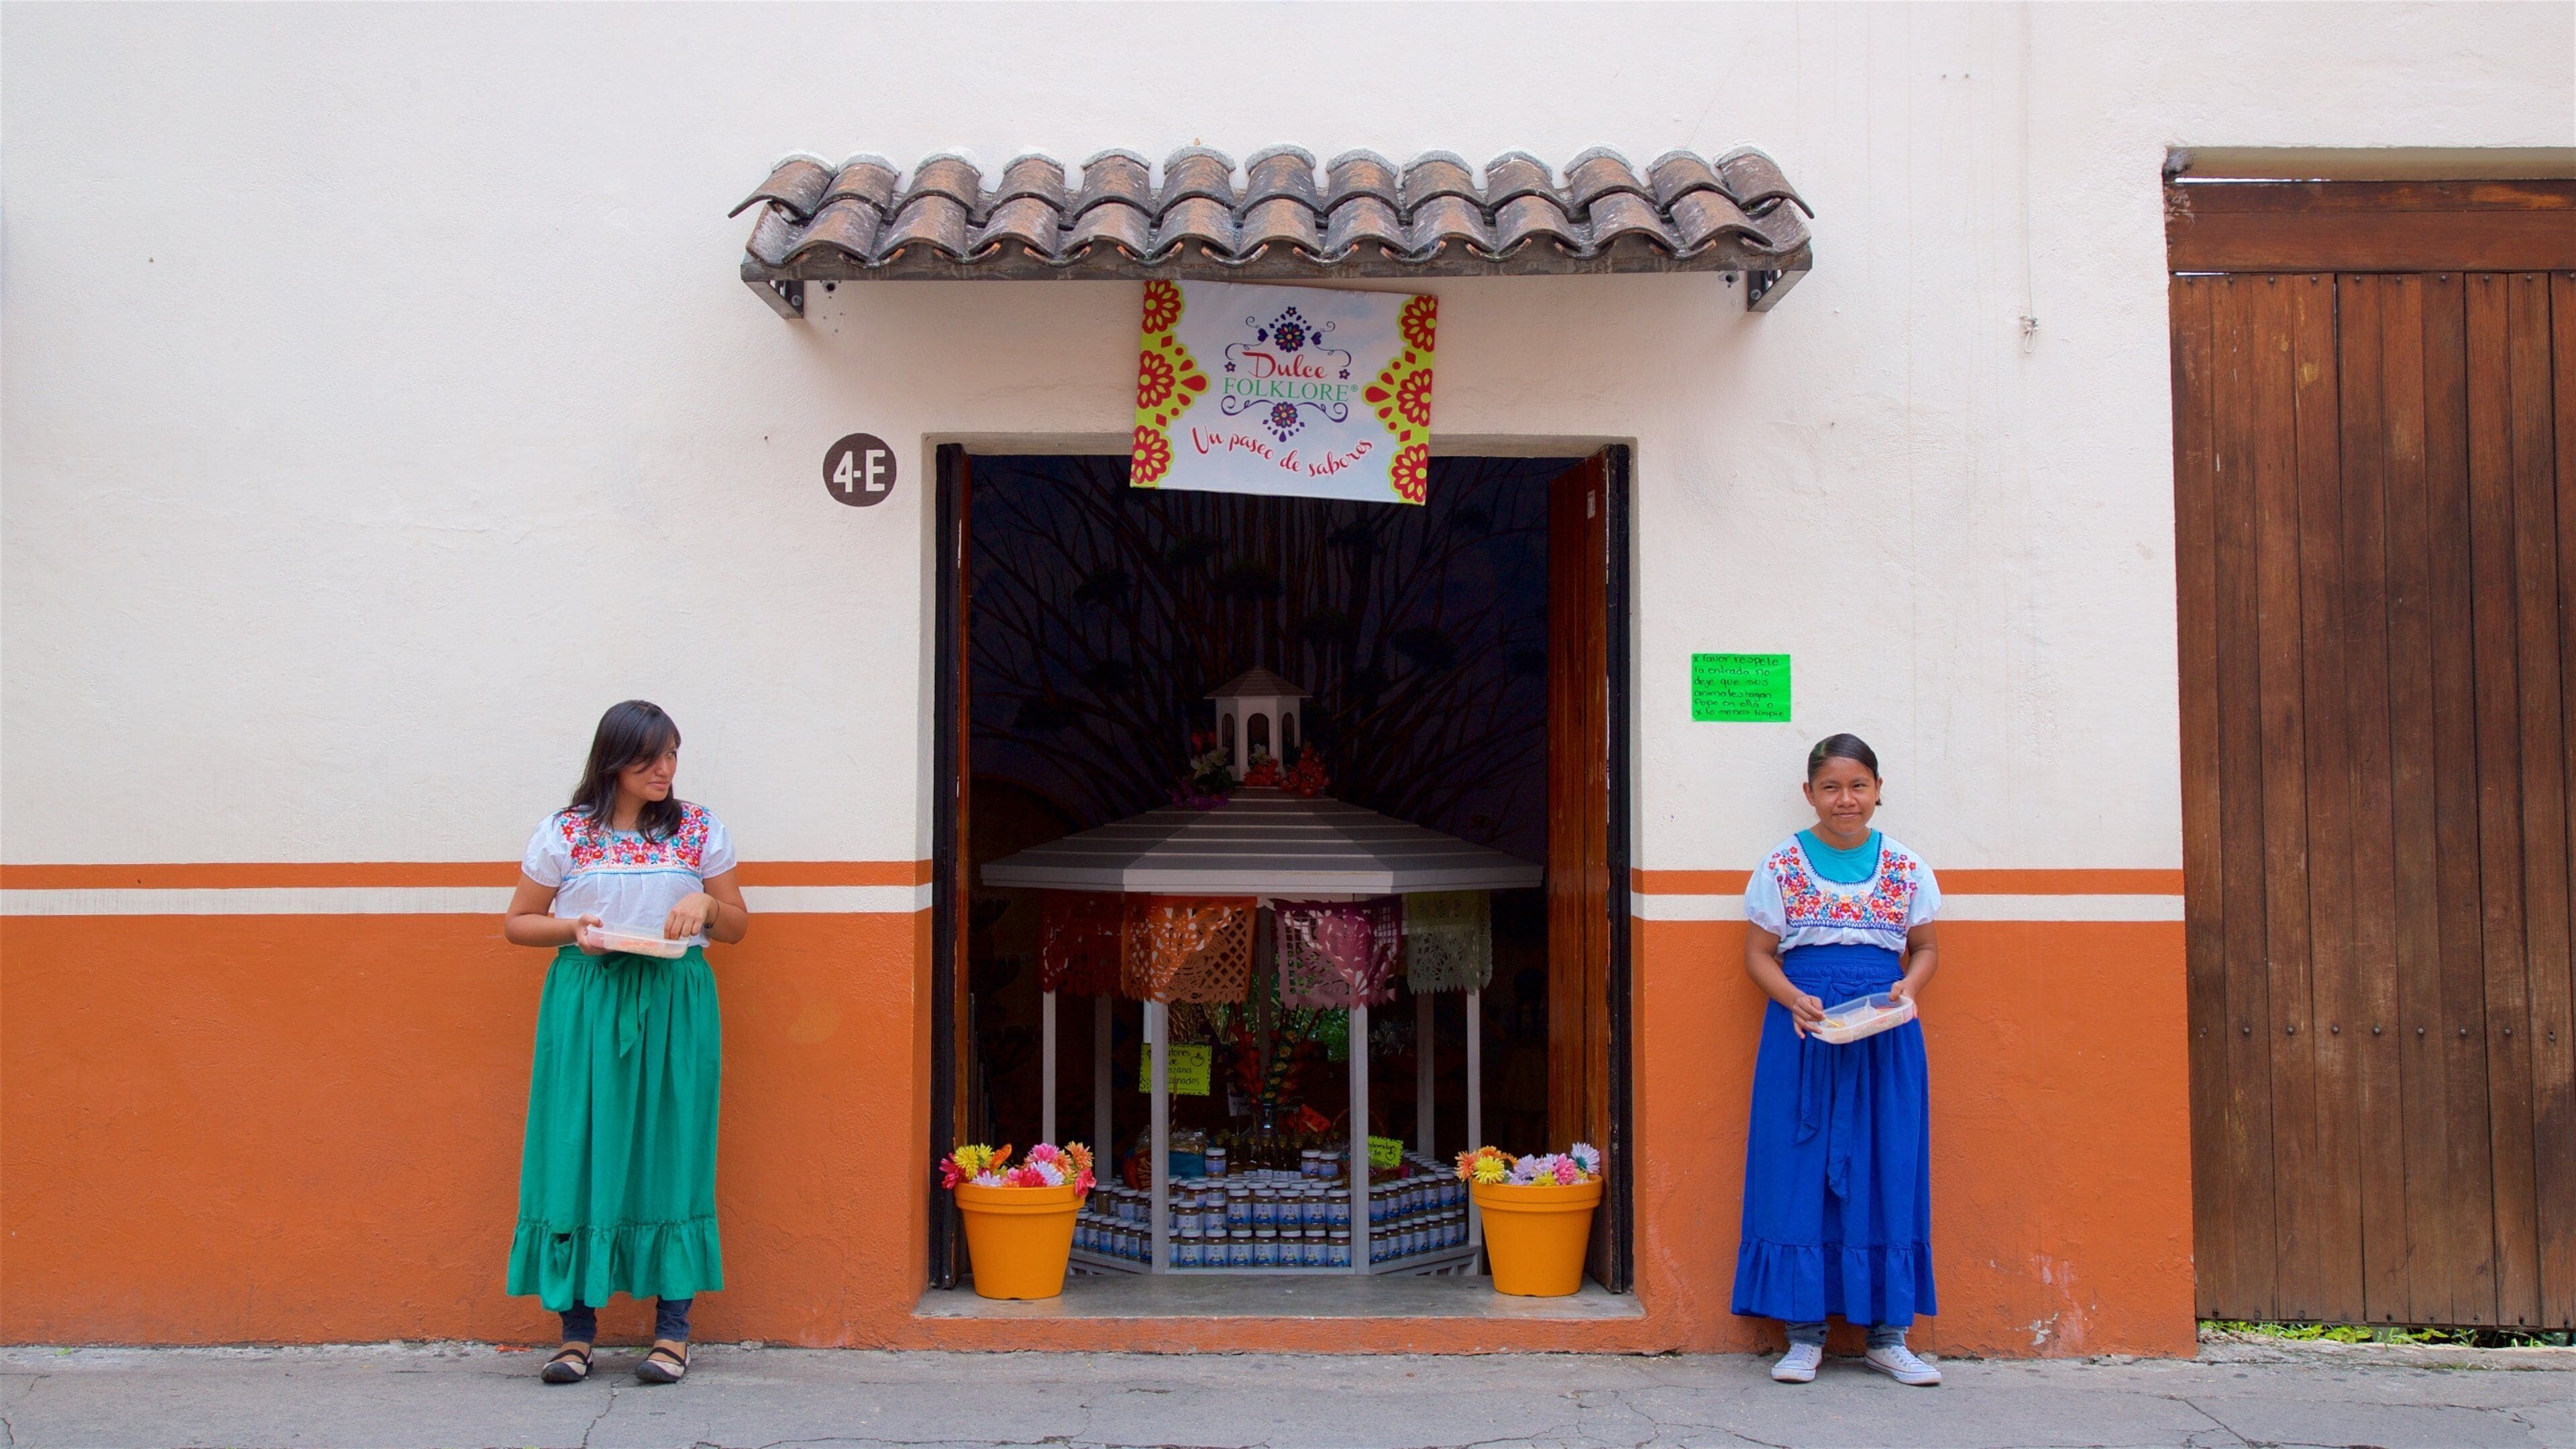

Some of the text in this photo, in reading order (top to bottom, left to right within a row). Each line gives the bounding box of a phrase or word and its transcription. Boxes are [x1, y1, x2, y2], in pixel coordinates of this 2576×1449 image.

[1242, 351, 1328, 380] Dulce
[1192, 425, 1373, 477] Un paseo de sabores
[833, 449, 885, 492] 4-E
[1703, 654, 1729, 663] favor
[1721, 679, 1739, 688] que
[1740, 699, 1759, 708] ella
